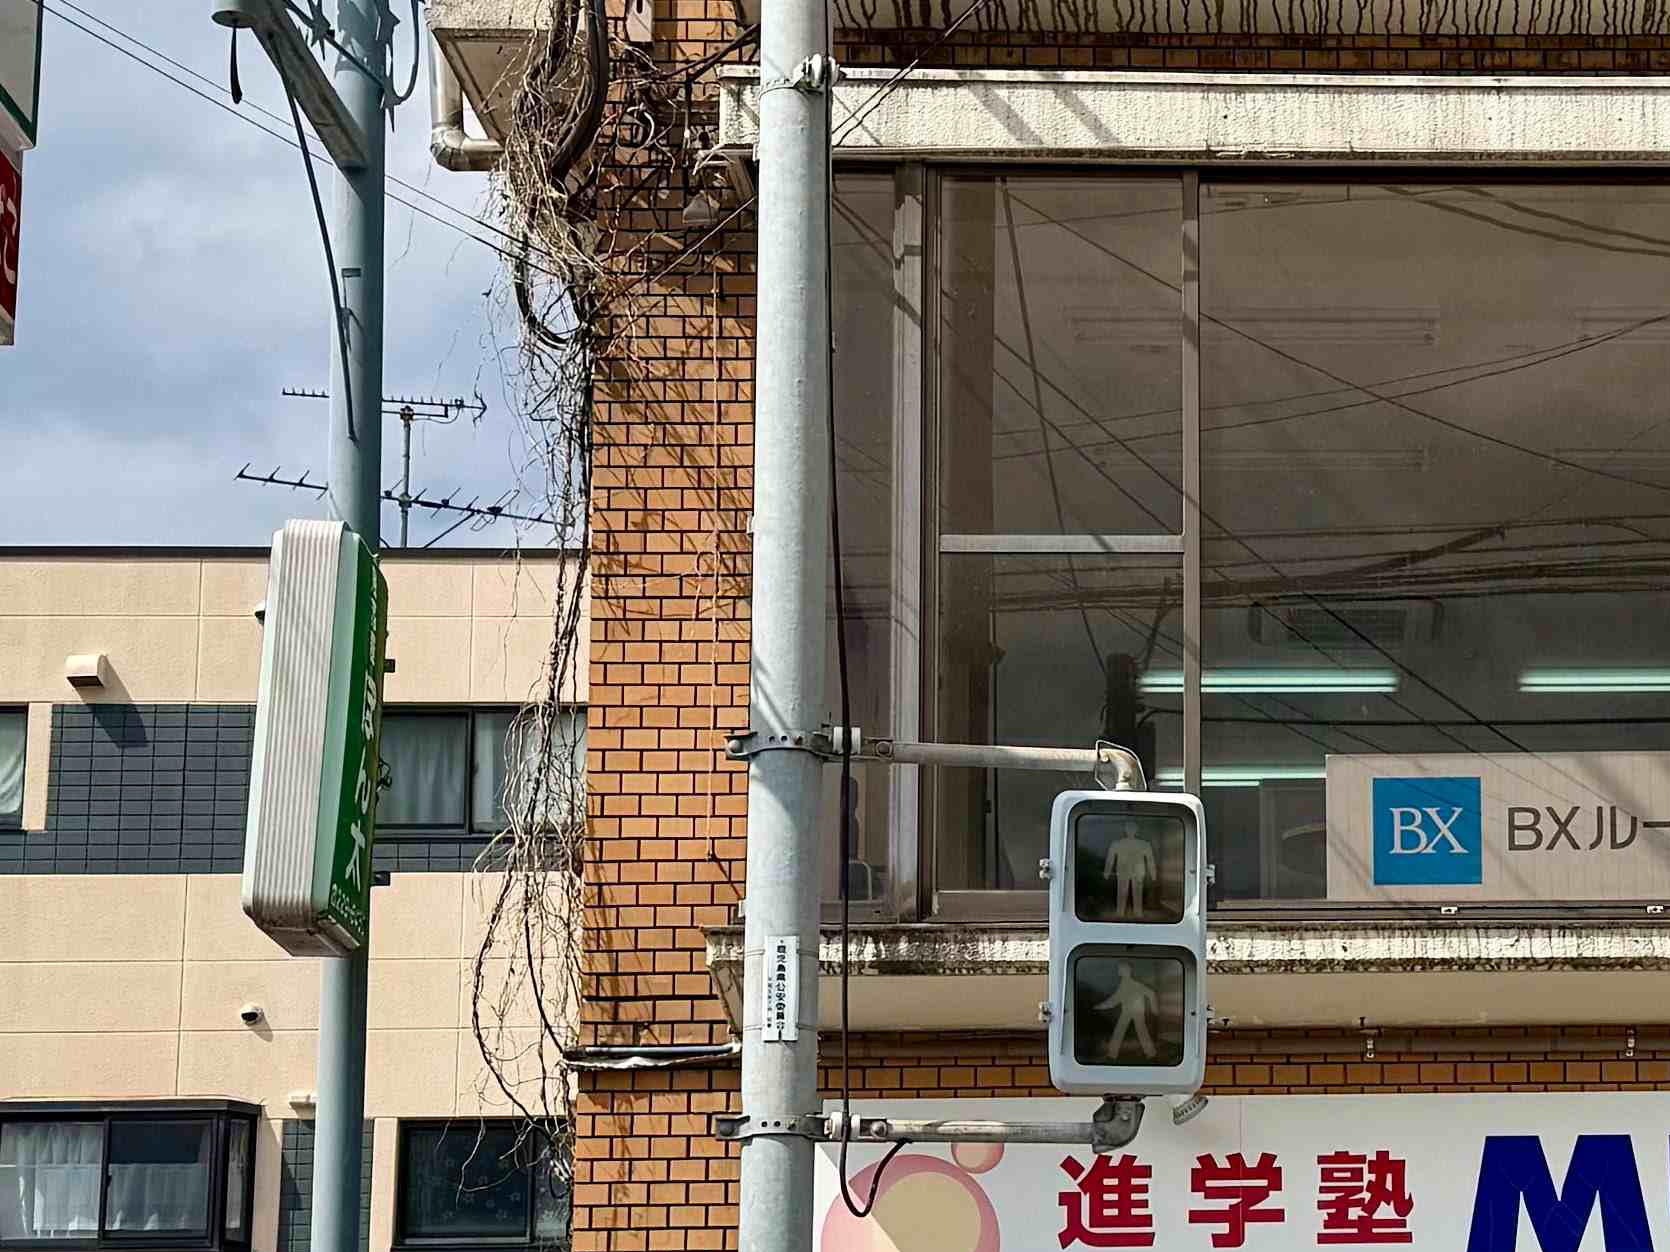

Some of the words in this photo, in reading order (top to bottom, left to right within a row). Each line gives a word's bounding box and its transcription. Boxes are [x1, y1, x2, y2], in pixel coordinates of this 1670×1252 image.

[1388, 807, 1469, 855] BX
[1058, 1150, 1415, 1250] 進学塾
